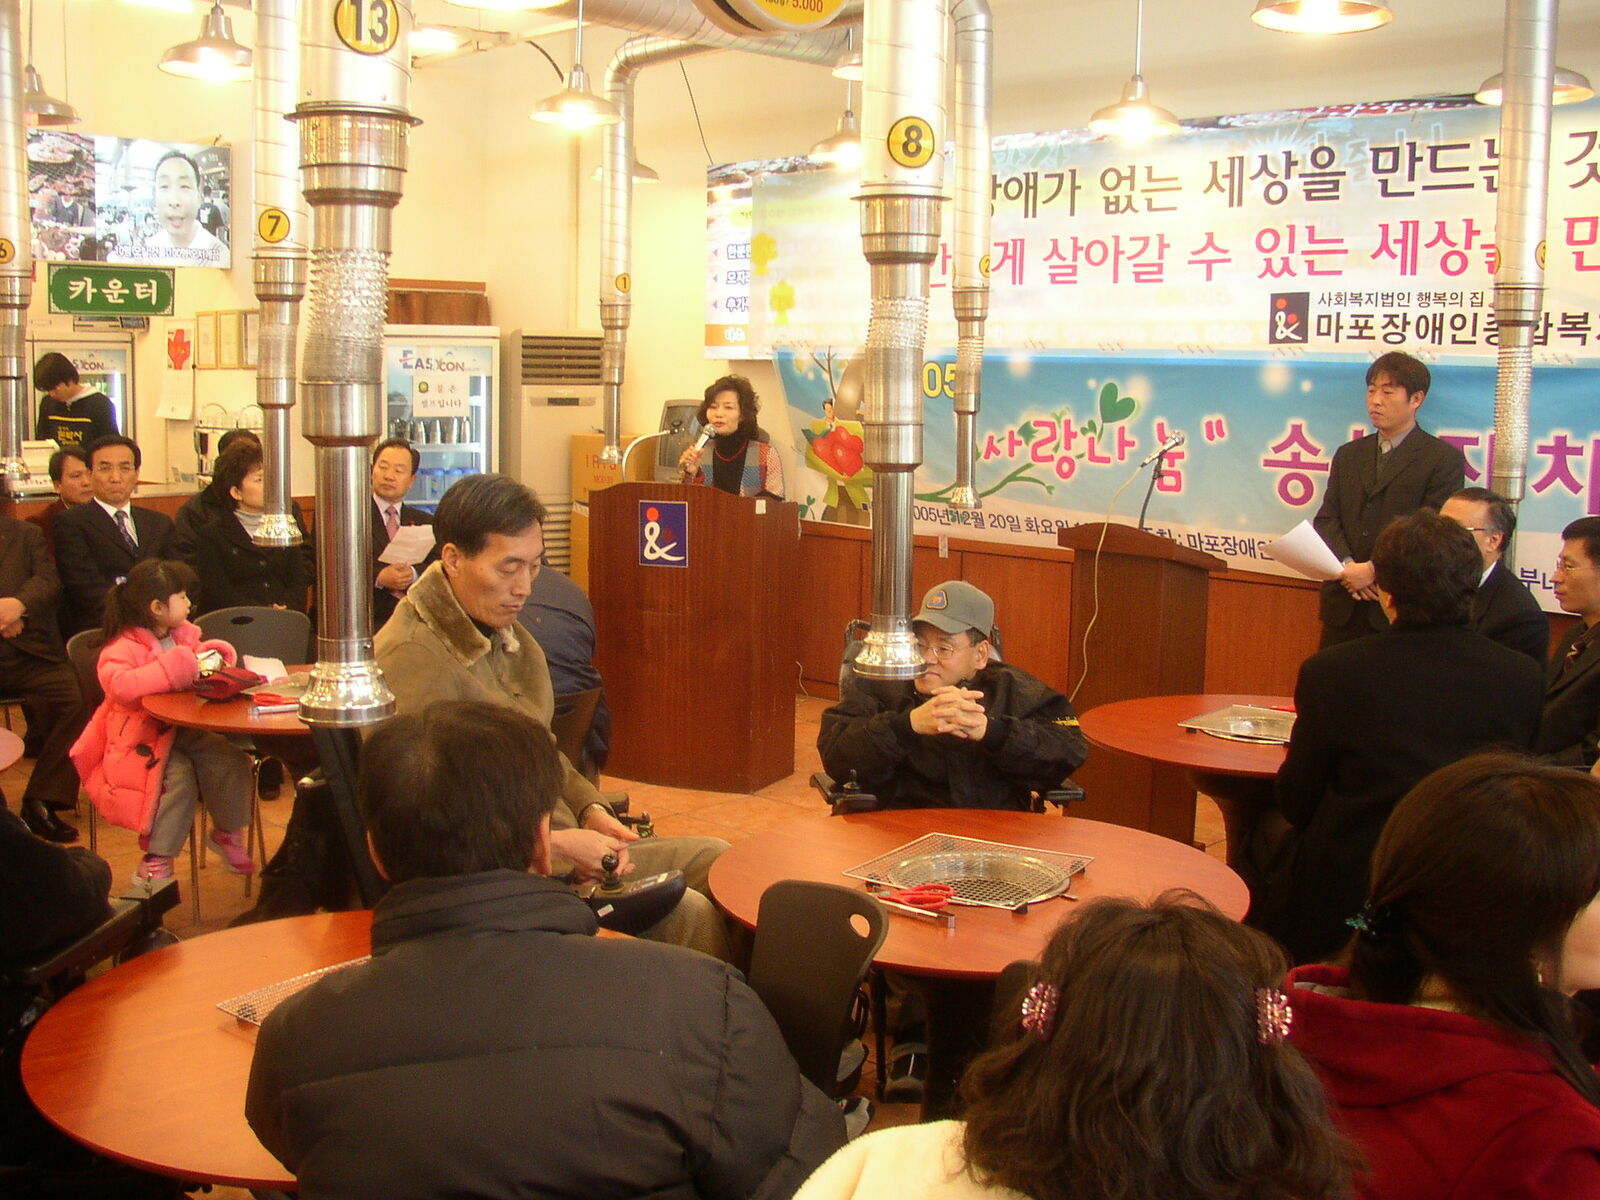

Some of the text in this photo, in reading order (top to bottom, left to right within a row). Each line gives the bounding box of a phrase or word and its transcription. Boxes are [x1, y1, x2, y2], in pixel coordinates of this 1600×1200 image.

[351, 0, 389, 44] 13
[902, 125, 922, 158] 8
[1099, 165, 1182, 215] 없는
[1203, 144, 1346, 209] 세상을
[267, 215, 282, 236] 7
[1043, 233, 1170, 285] 살아갈
[1187, 232, 1232, 282] 수
[1255, 224, 1349, 279] 있는
[68, 276, 158, 305] 카운터
[1318, 291, 1485, 308] 사회복지법인 행복의 집
[988, 513, 1022, 533] 20일
